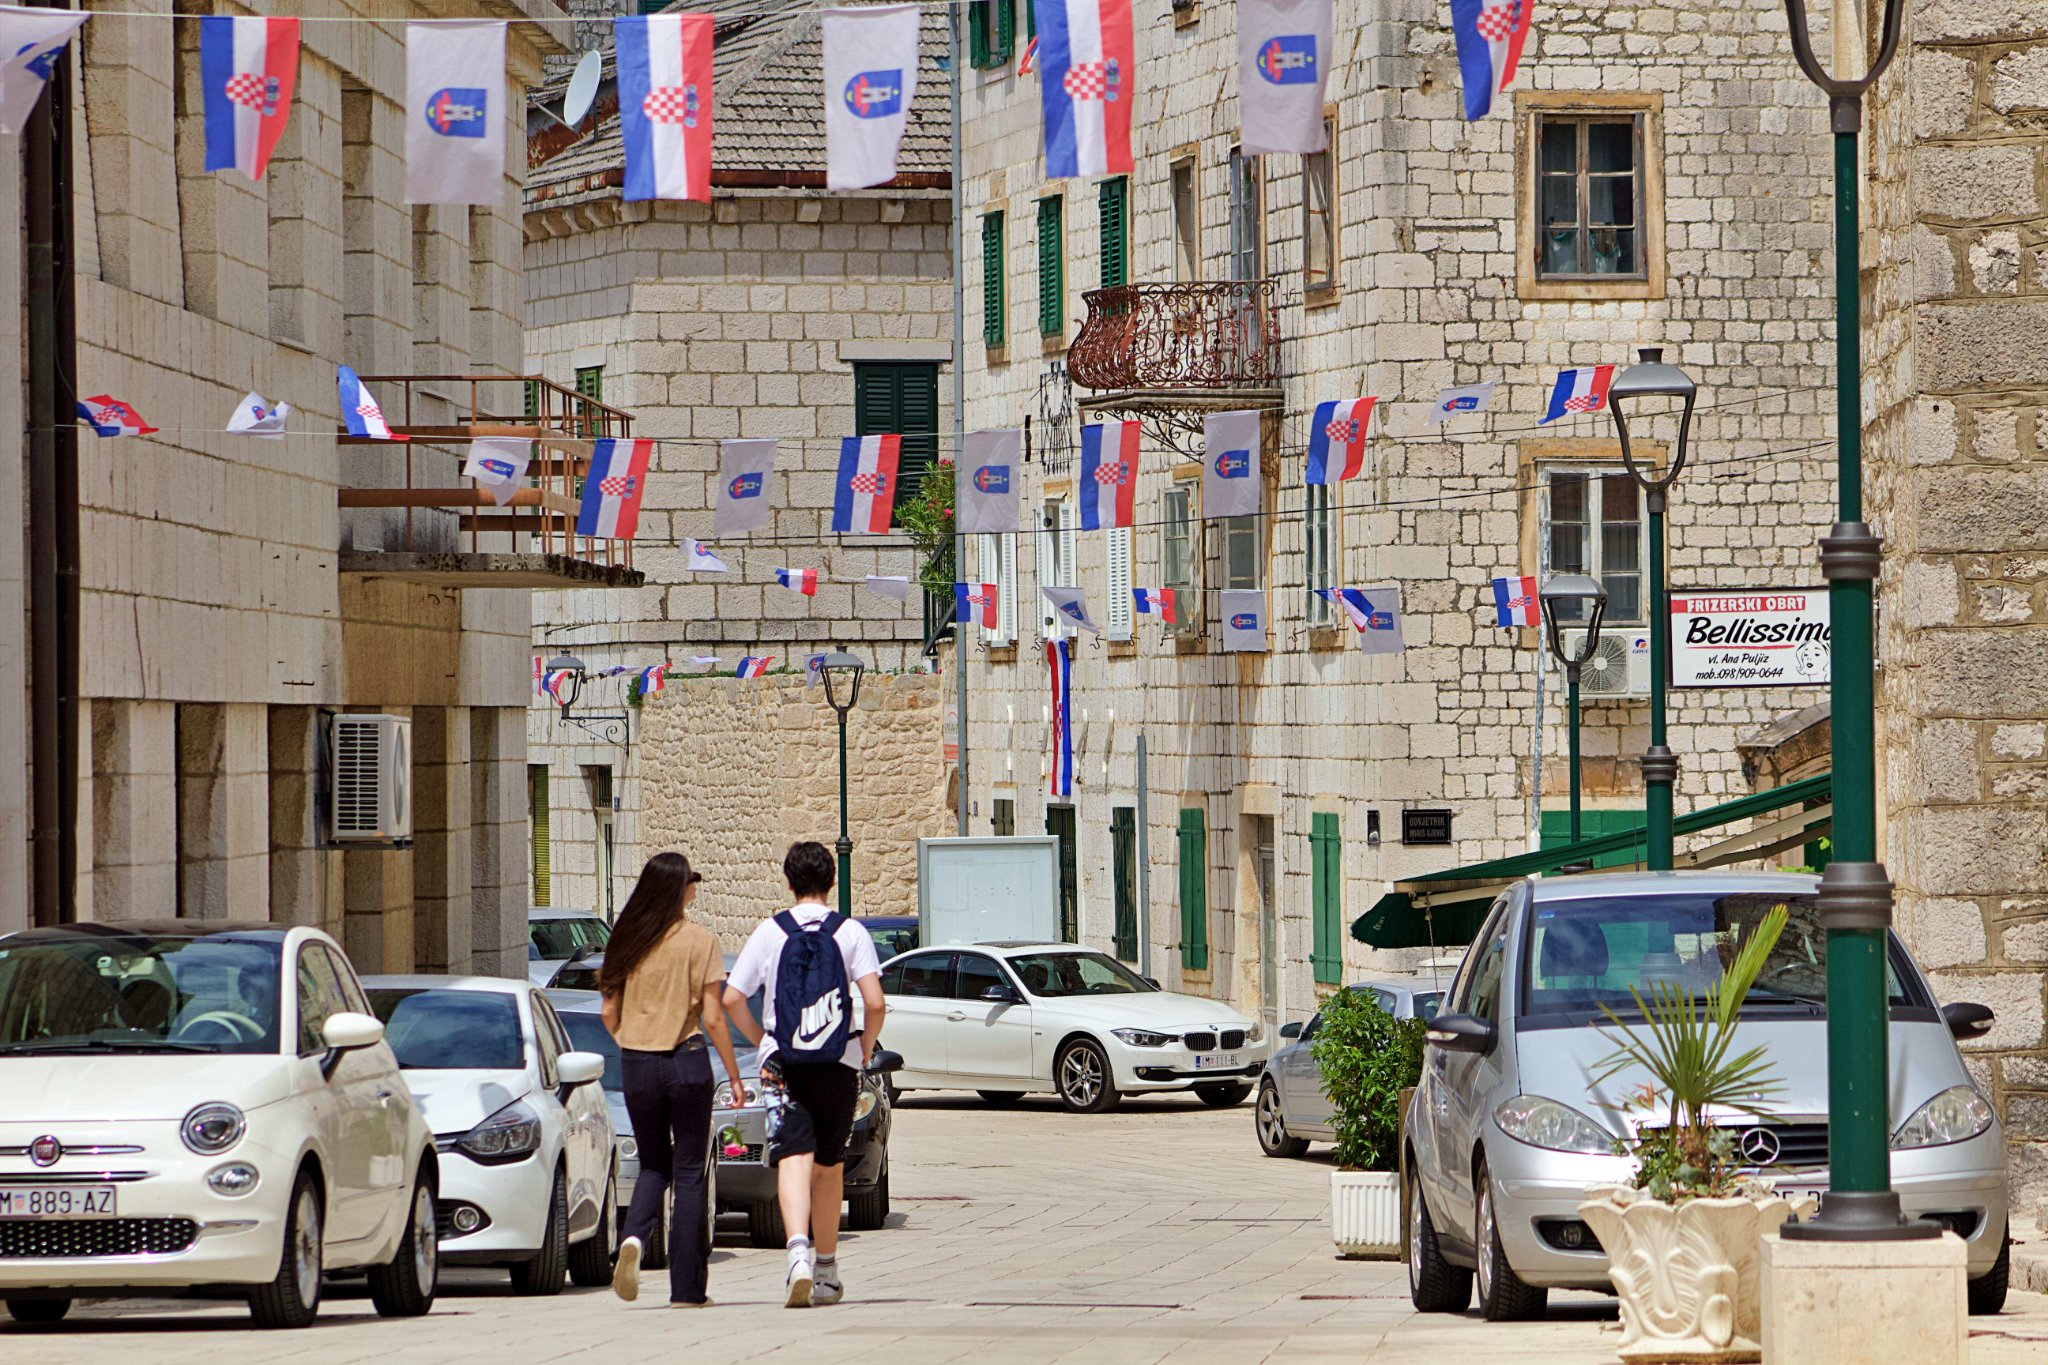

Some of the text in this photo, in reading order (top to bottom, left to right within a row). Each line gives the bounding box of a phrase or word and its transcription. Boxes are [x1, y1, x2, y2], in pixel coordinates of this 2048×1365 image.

[1687, 596, 1805, 613] FRIZERSKI OBRT
[1708, 653, 1769, 666] vl. Ana Puljiz
[800, 987, 843, 1036] NIKE
[30, 1191, 111, 1214] 889-AZ
